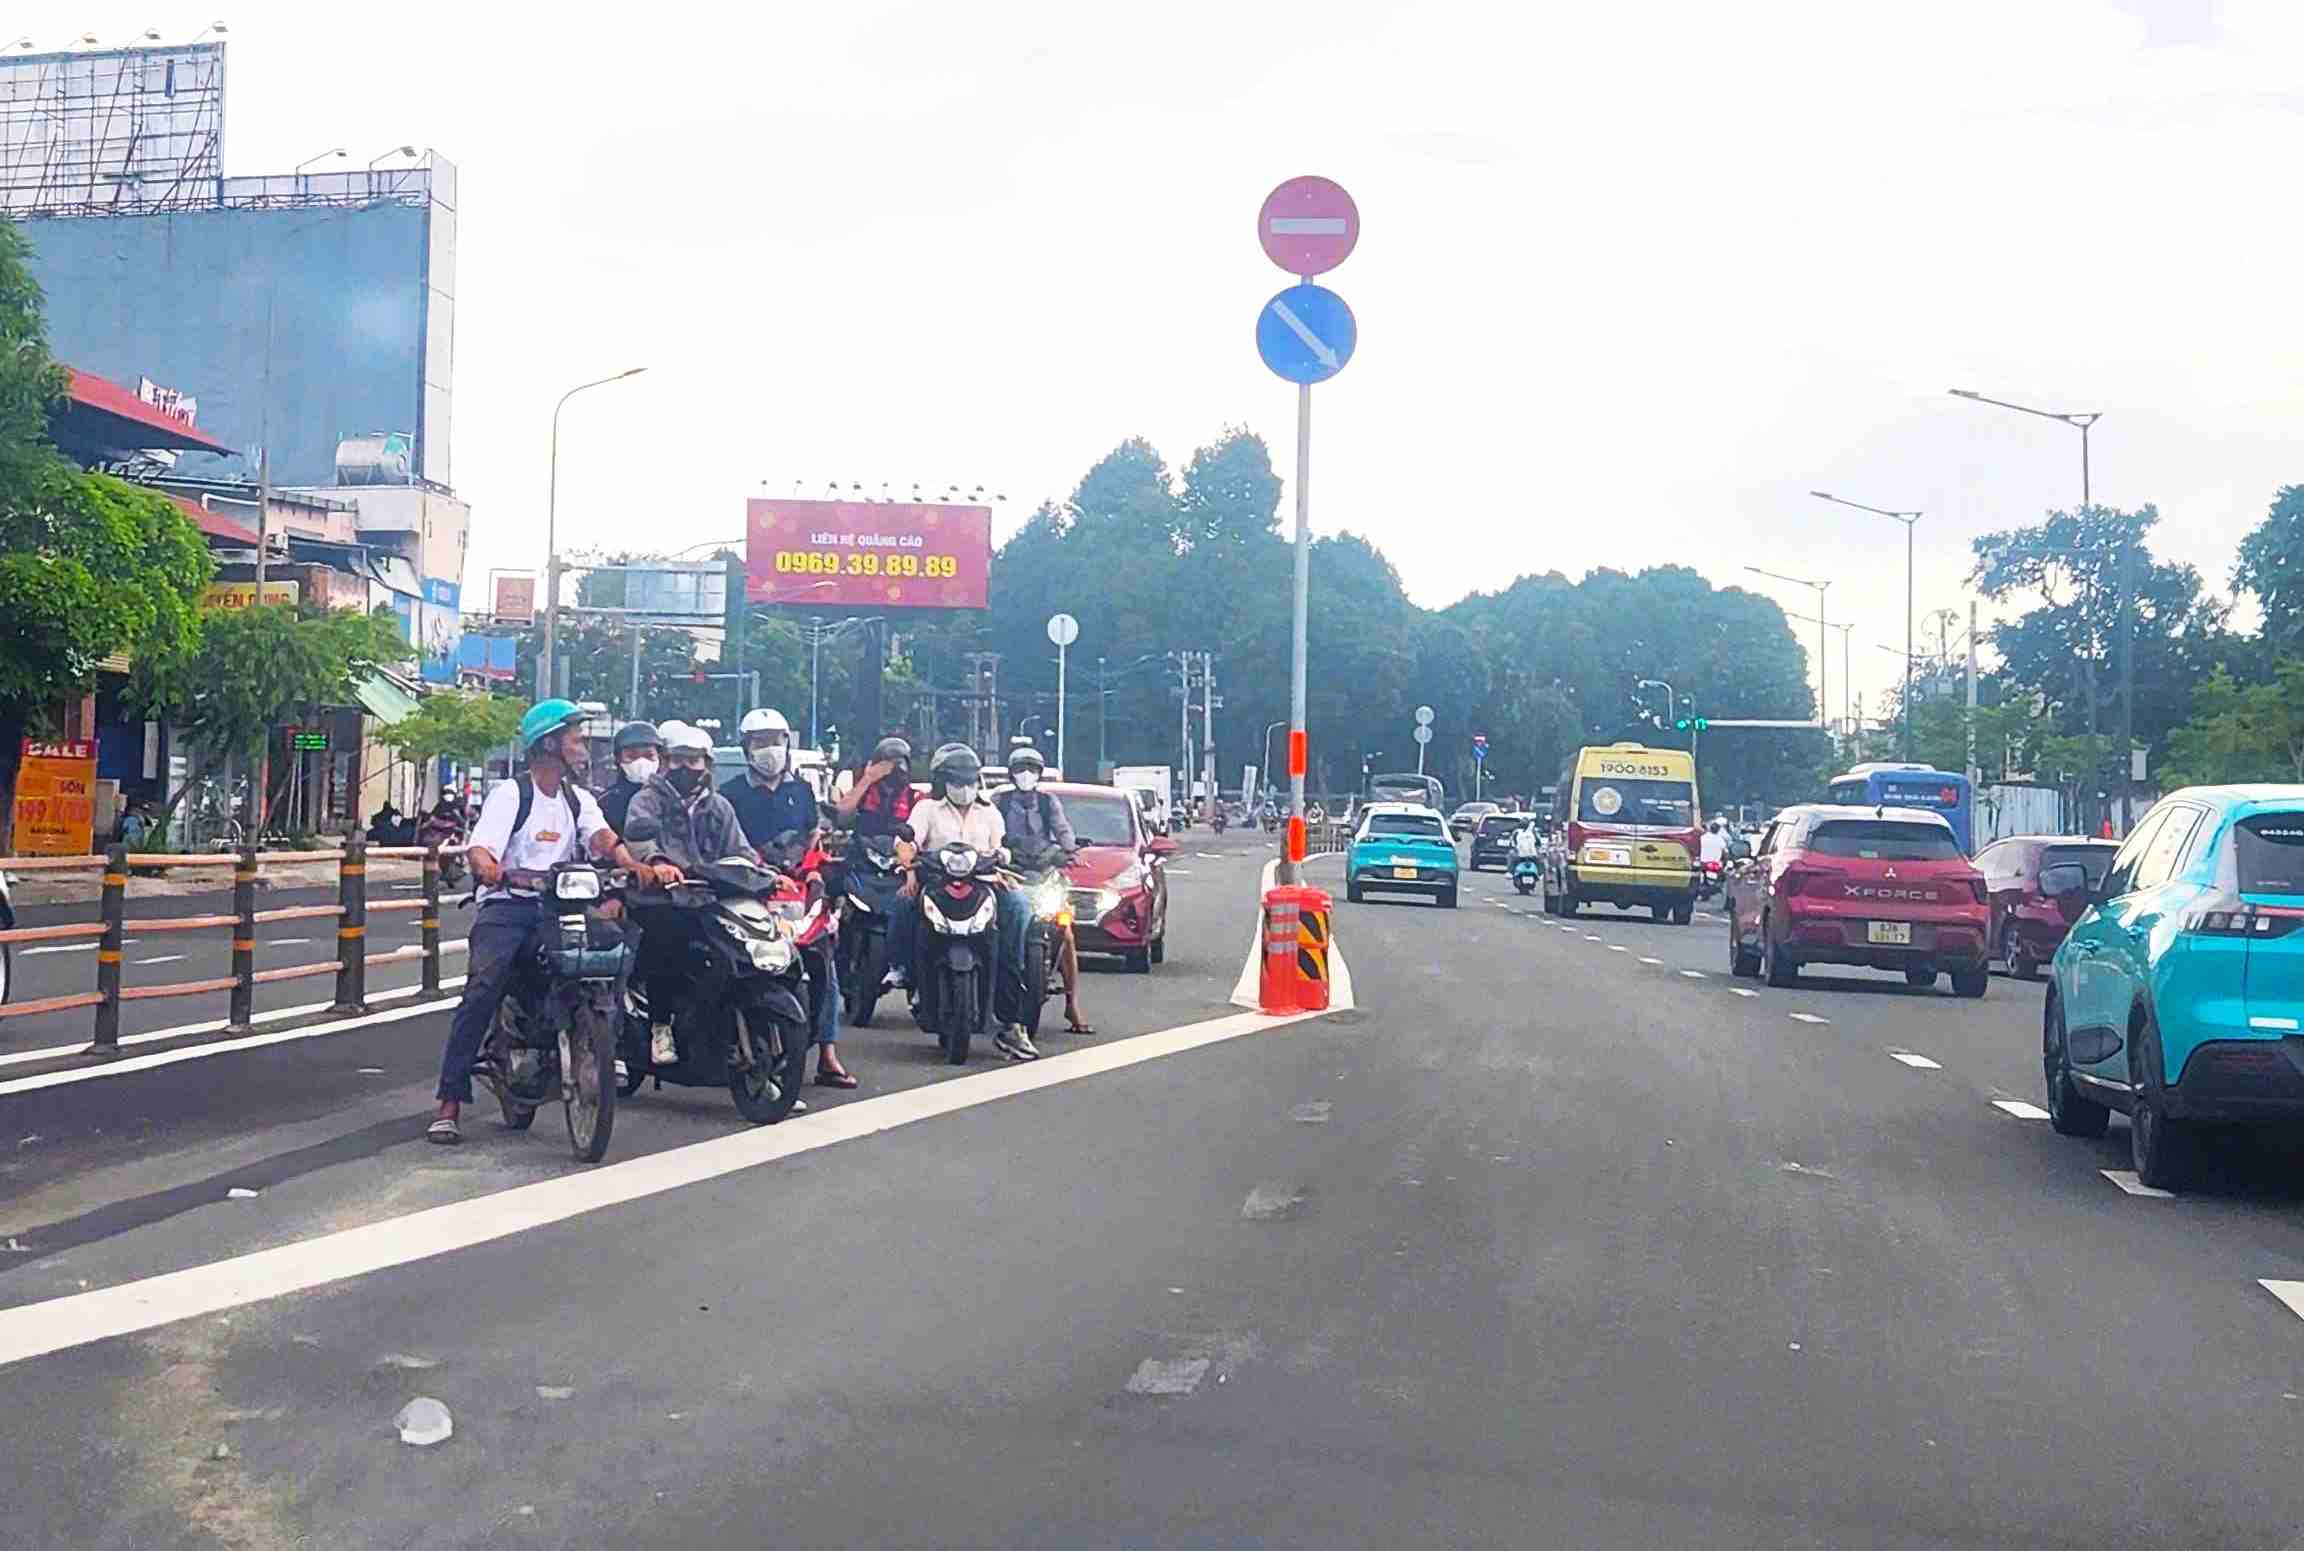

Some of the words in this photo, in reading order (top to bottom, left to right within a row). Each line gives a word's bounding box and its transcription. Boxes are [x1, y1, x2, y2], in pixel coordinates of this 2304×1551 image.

[811, 532, 837, 545] LIÊN
[858, 533, 897, 548] QUẢNG
[899, 534, 923, 548] CÁO
[775, 551, 957, 577] 0969.39.89.89
